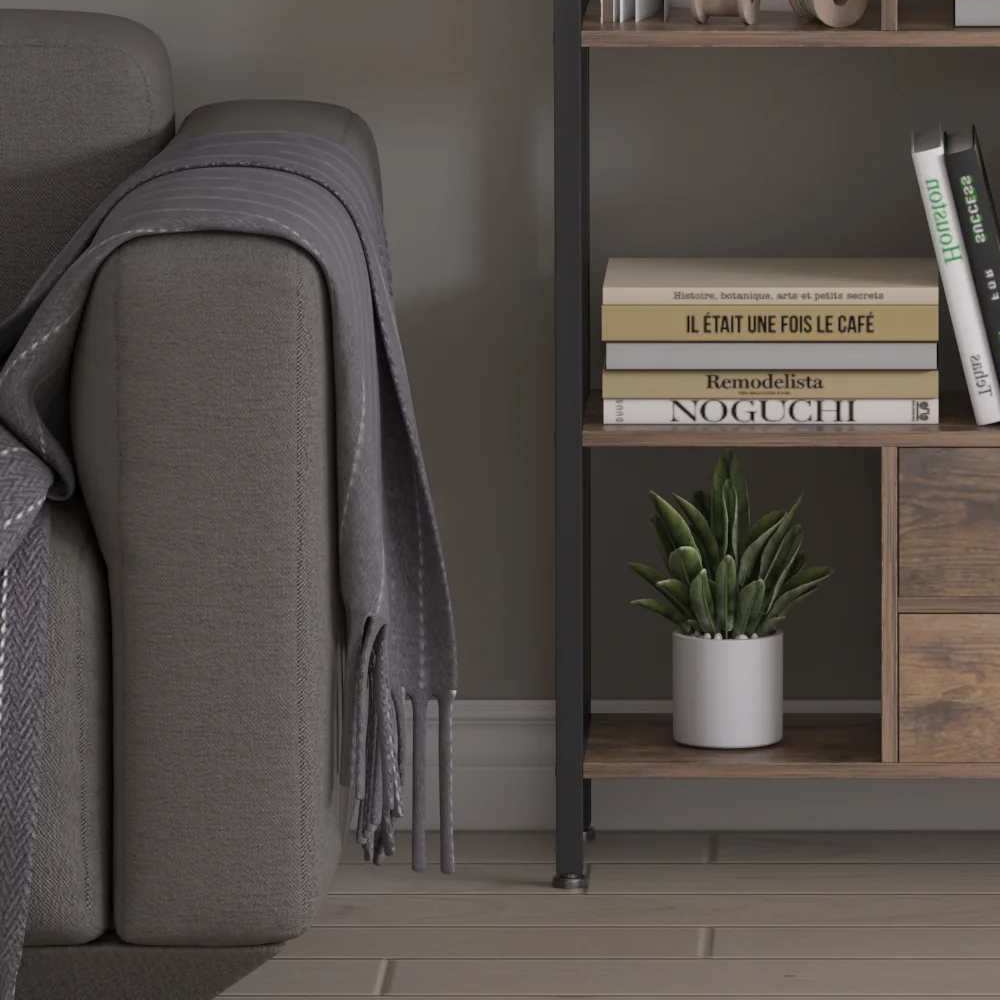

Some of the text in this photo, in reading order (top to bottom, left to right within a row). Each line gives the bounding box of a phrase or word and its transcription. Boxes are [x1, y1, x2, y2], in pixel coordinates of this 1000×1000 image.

[673, 291, 884, 302] Histoire, botanique, arts et petits secrets
[686, 311, 874, 333] IL ÉTAIT UNE FOIS LE CAFÉ
[706, 374, 824, 390] Remodelista
[670, 400, 856, 423] NOGUCHI
